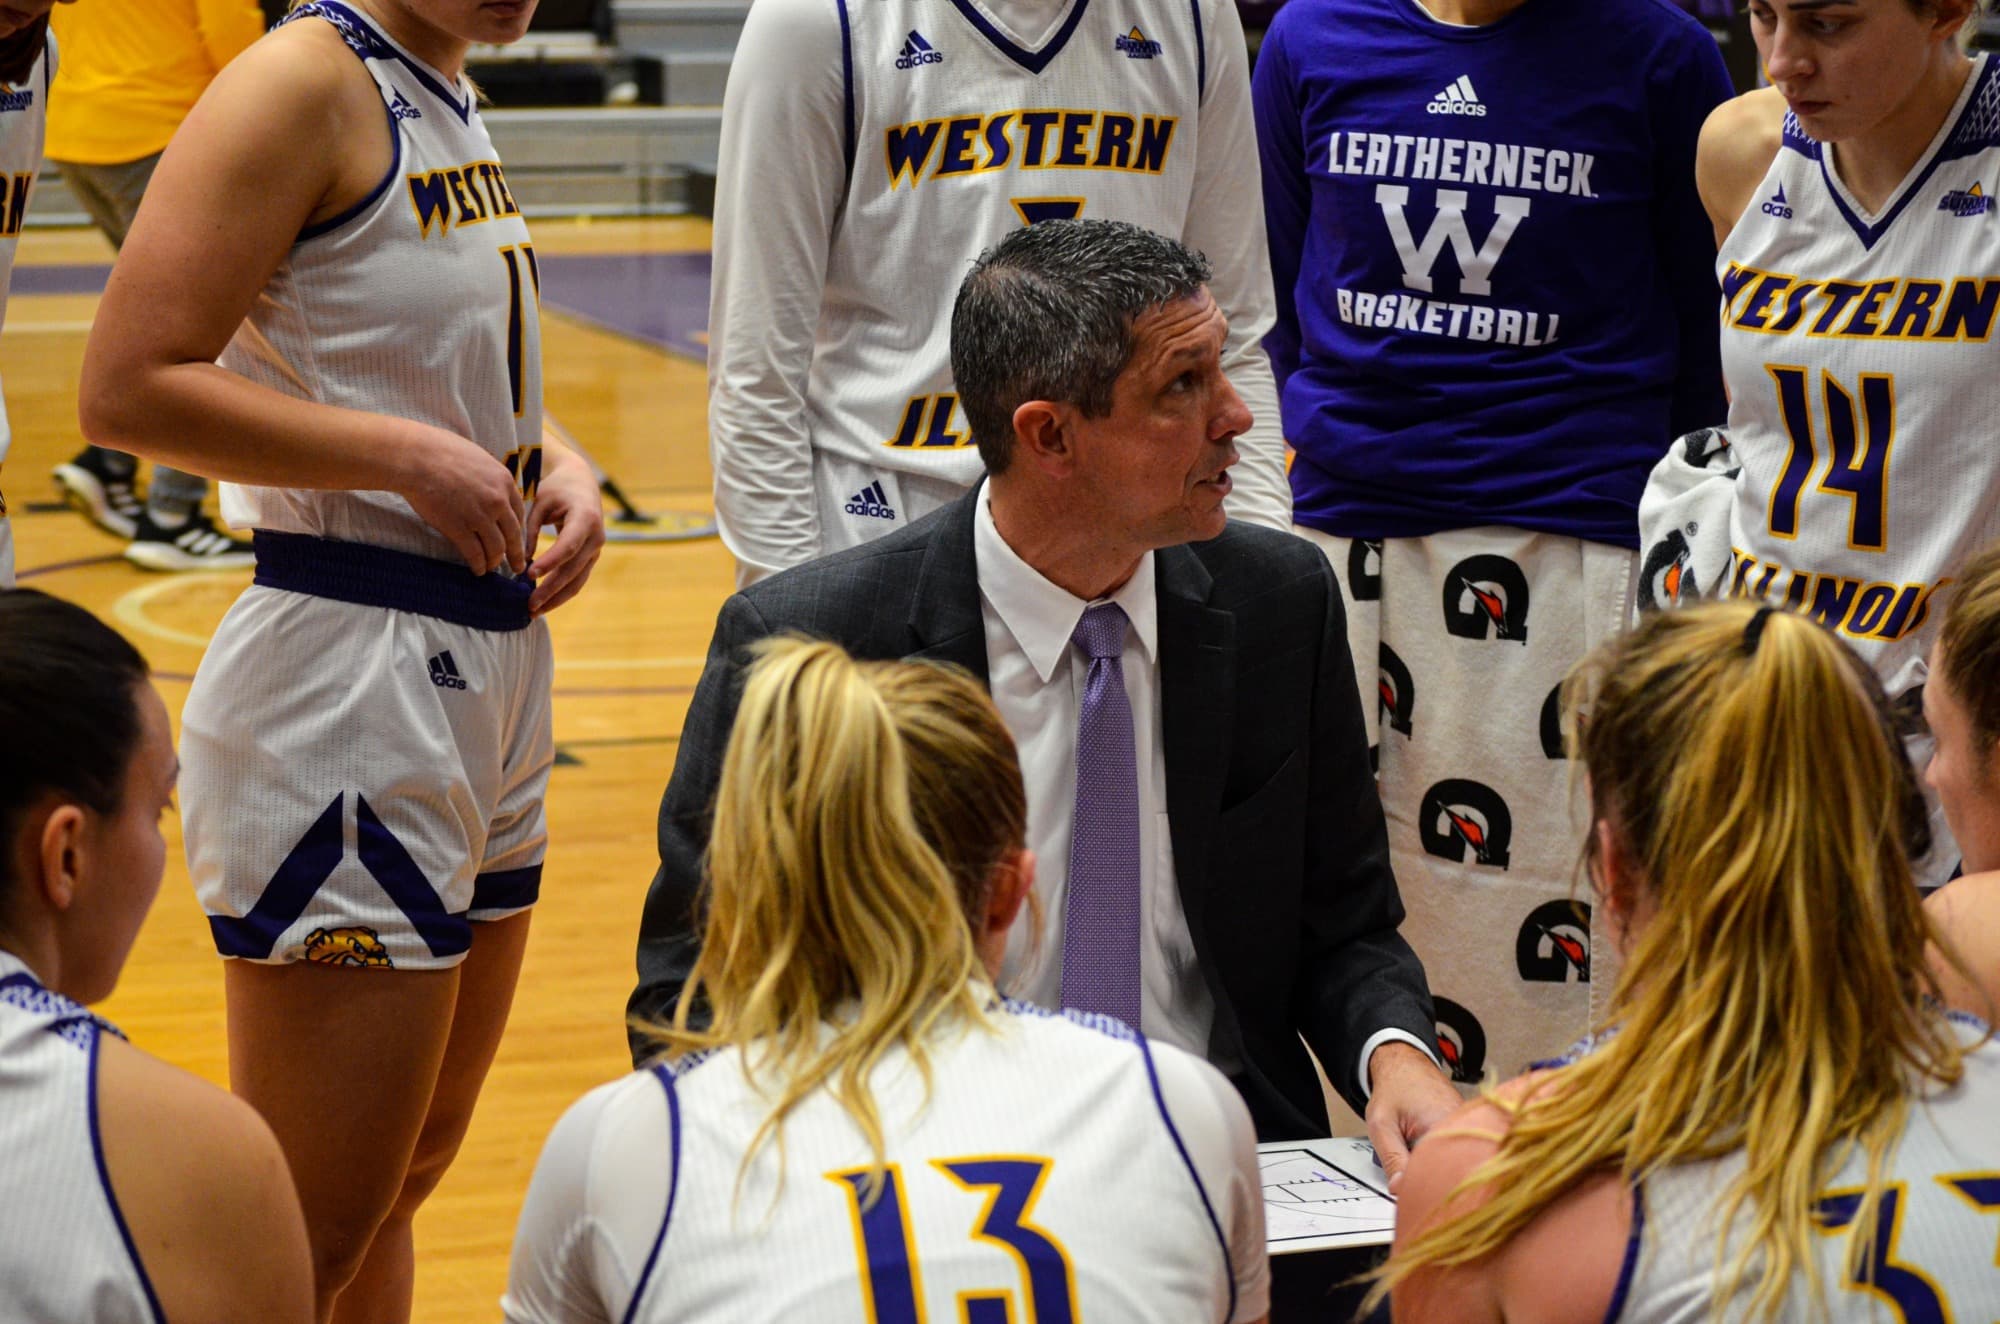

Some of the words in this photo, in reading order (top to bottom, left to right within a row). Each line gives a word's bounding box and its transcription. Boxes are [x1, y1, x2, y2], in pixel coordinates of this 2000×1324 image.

[895, 51, 943, 70] adidas
[1426, 100, 1487, 116] adidas
[885, 110, 1178, 191] WESTERN
[1328, 132, 1597, 198] LEATHERNECK
[406, 160, 524, 241] WESTE
[1375, 183, 1531, 296] W
[1336, 288, 1560, 346] BASKETBALL
[1763, 363, 1896, 552] 14
[844, 502, 895, 520] adidas
